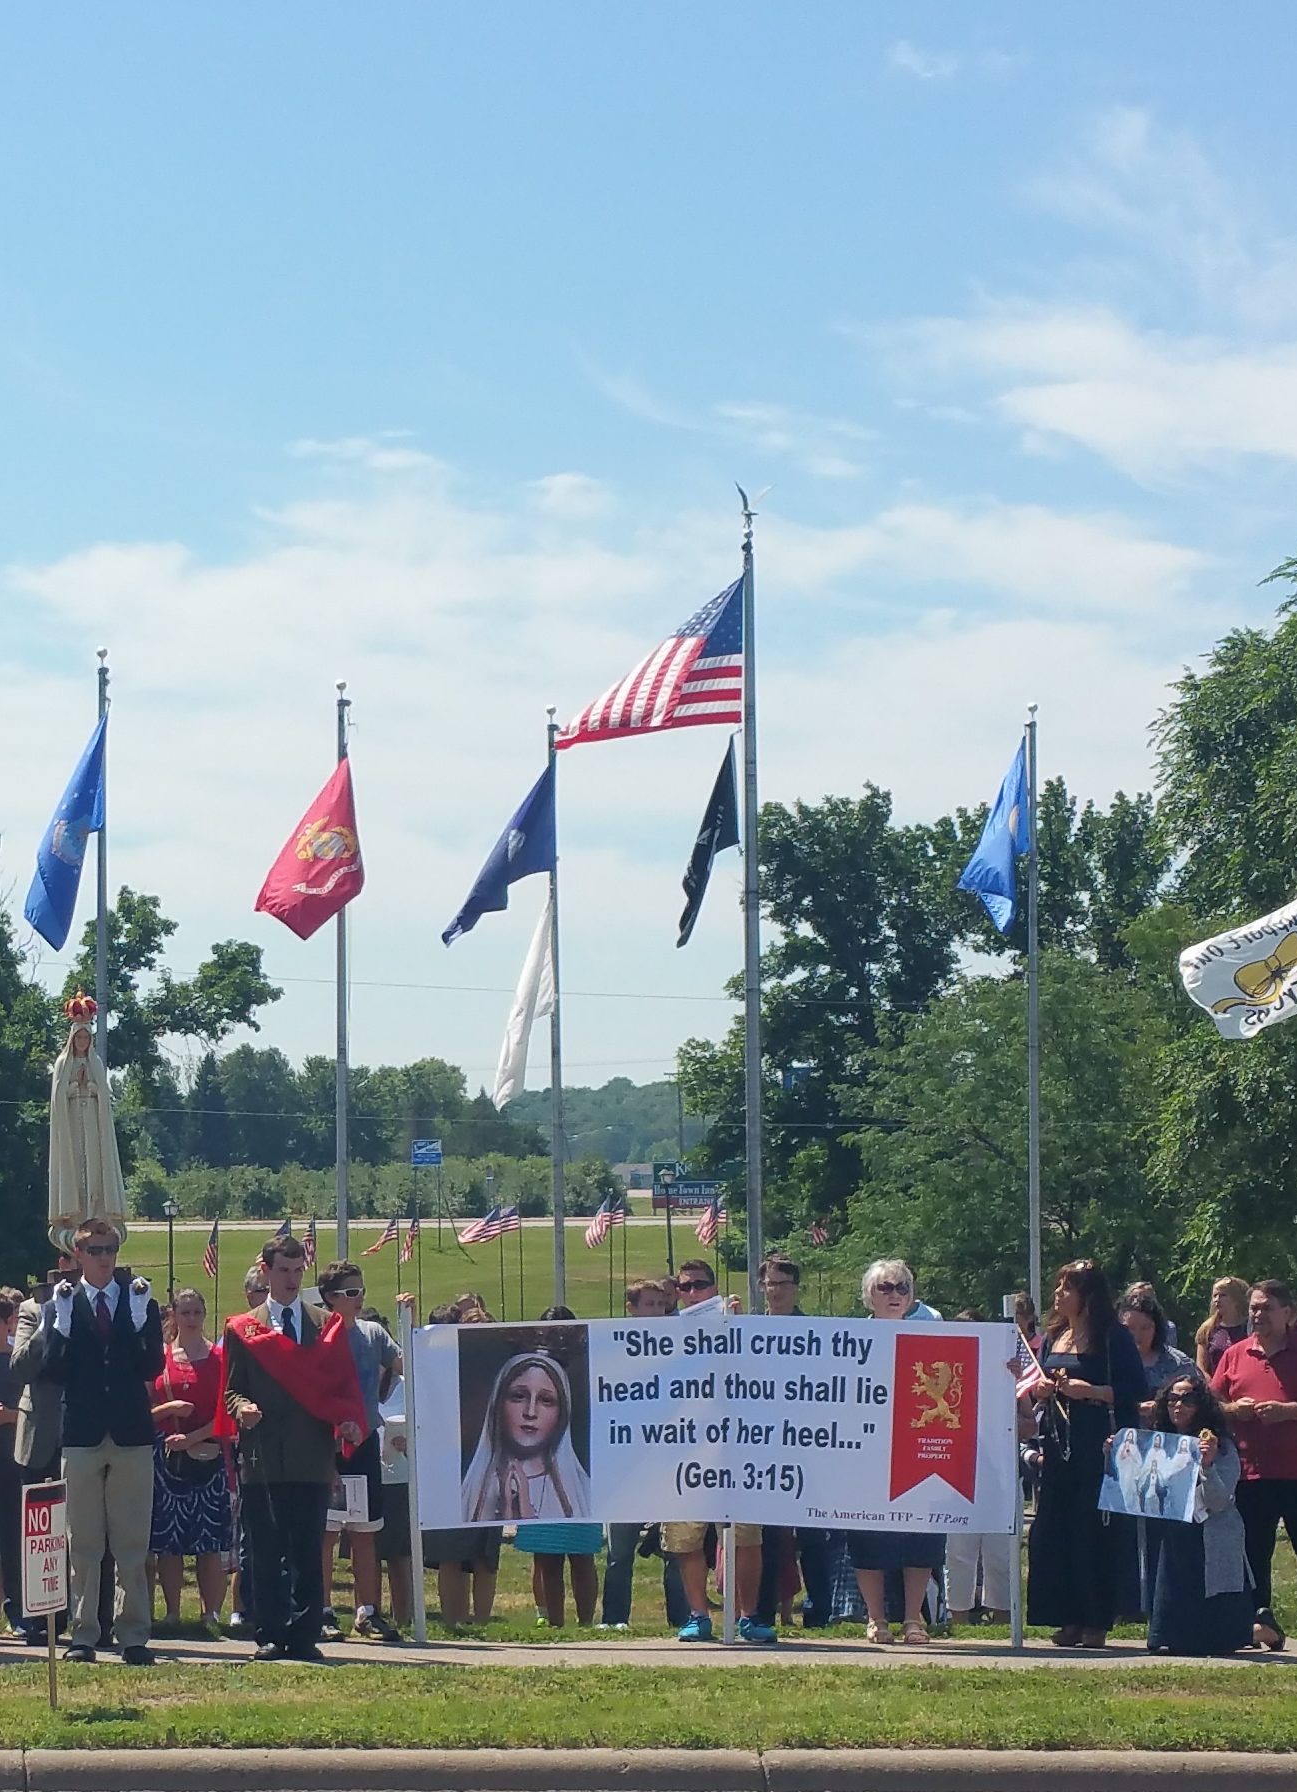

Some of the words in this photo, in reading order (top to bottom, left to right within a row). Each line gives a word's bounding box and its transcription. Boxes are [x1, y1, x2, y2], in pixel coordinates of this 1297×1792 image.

[613, 1330, 673, 1357] "She
[684, 1328, 742, 1355] shall
[751, 1330, 821, 1356] crush
[832, 1331, 873, 1365] thy
[598, 1375, 659, 1402] head
[670, 1373, 715, 1400] and
[725, 1373, 775, 1400] thou
[784, 1375, 846, 1403] shall
[857, 1377, 888, 1405] lie
[610, 1420, 632, 1444] in
[642, 1418, 696, 1444] wait
[706, 1417, 729, 1443] of
[736, 1418, 775, 1445] her
[782, 1419, 875, 1449] heel..."
[676, 1462, 736, 1496] (Gen.
[743, 1463, 804, 1499] 3:15)
[28, 1506, 49, 1532] NO
[806, 1508, 827, 1518] The
[831, 1509, 885, 1521] American
[888, 1512, 913, 1522] TFP
[928, 1513, 969, 1525] TFP.org
[31, 1535, 64, 1554] PARKING
[43, 1556, 58, 1573] ANY
[42, 1575, 59, 1593] TIME
